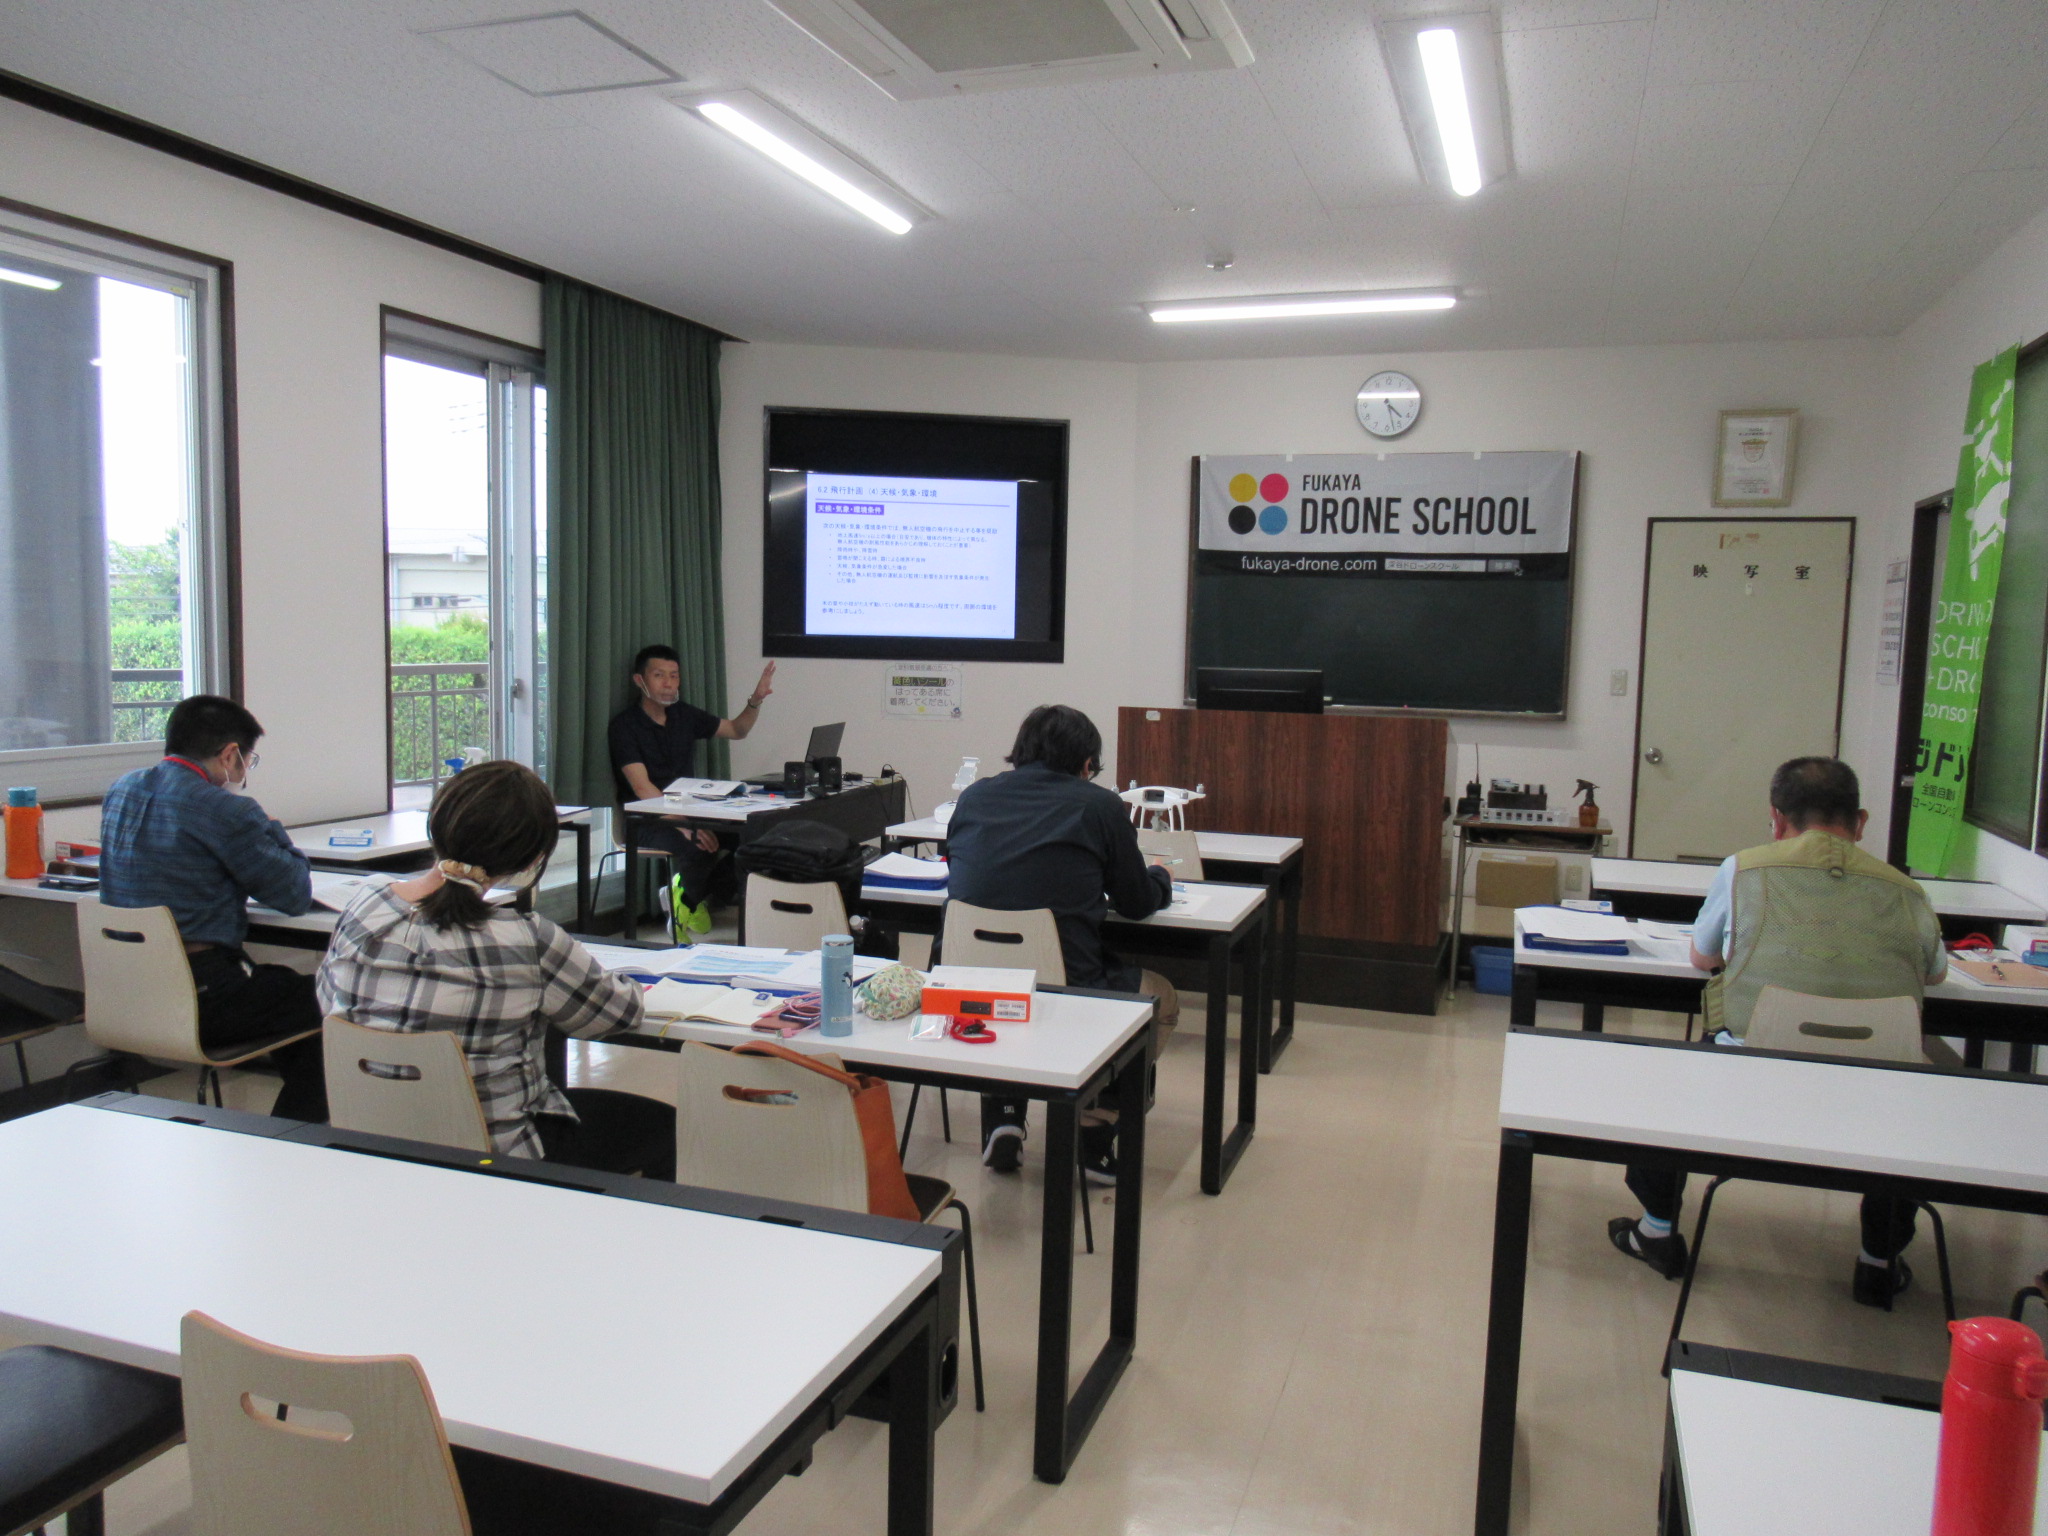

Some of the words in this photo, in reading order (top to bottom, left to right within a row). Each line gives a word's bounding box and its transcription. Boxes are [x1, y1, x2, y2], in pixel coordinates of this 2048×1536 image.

[817, 486, 828, 494] 6.2
[830, 485, 864, 496] 飛行計画
[1302, 474, 1361, 492] FUKAYA
[1301, 497, 1402, 535] DRONE
[1412, 497, 1538, 535] SCHOOL
[1241, 556, 1378, 572] fukaya-drone.com
[1931, 633, 1981, 660] SCH
